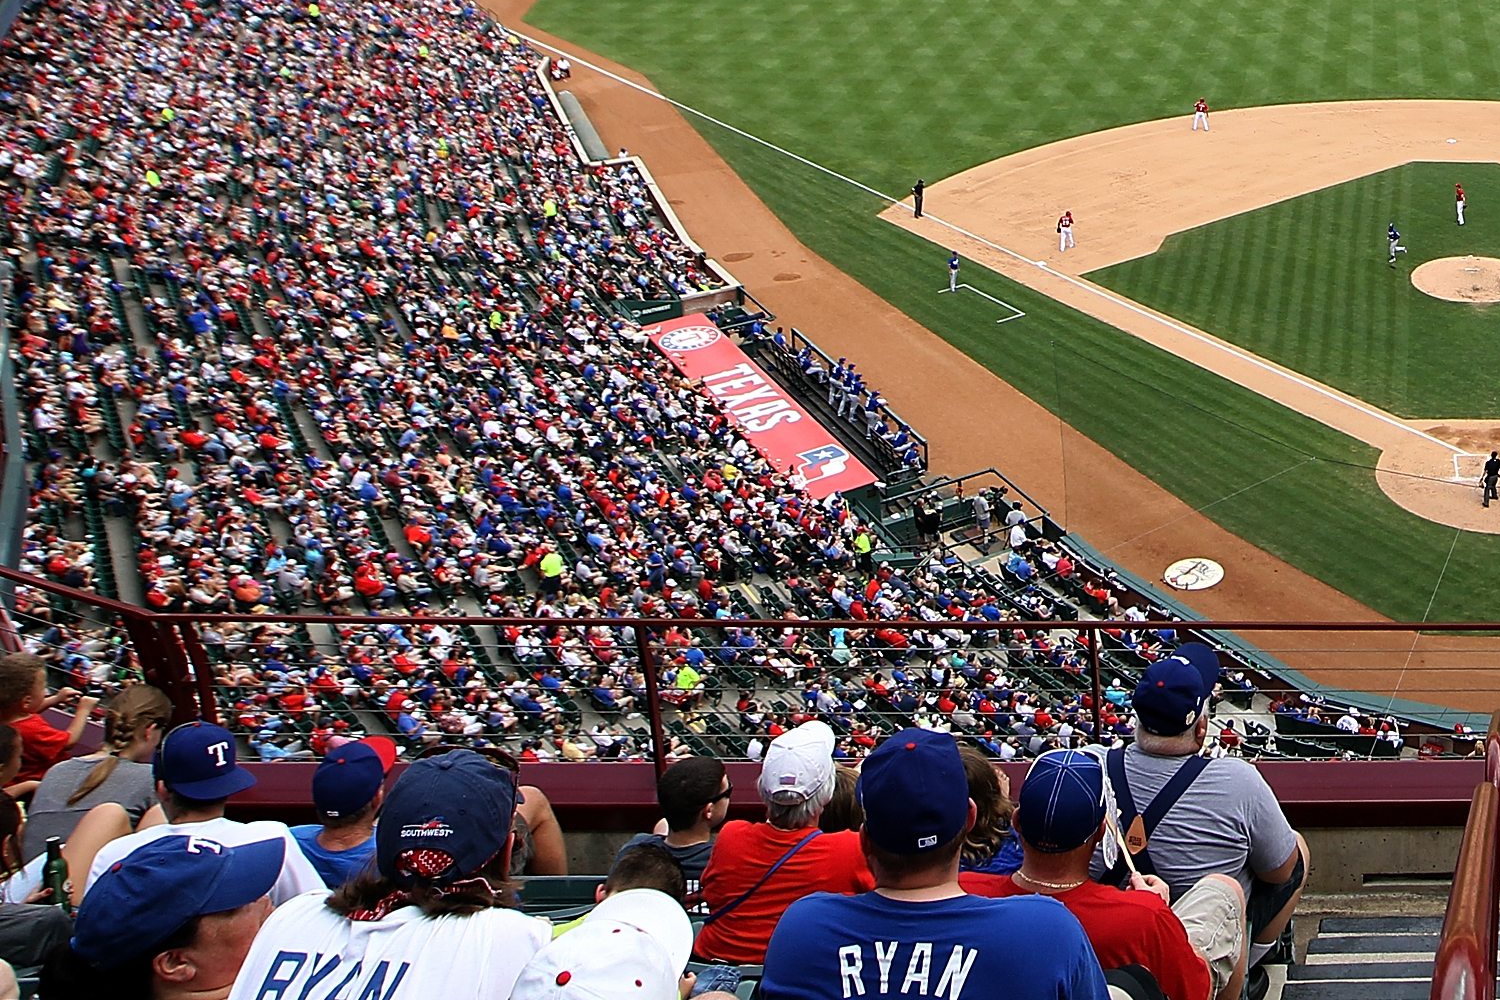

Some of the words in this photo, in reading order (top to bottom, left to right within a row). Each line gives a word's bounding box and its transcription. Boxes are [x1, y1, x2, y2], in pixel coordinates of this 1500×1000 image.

[642, 304, 671, 315] SOUTHWEST
[703, 363, 802, 433] TEXAS
[208, 741, 229, 767] T
[400, 829, 450, 837] SOUTHWEST
[256, 950, 410, 1000] RYAN
[838, 941, 978, 1000] RYAN
